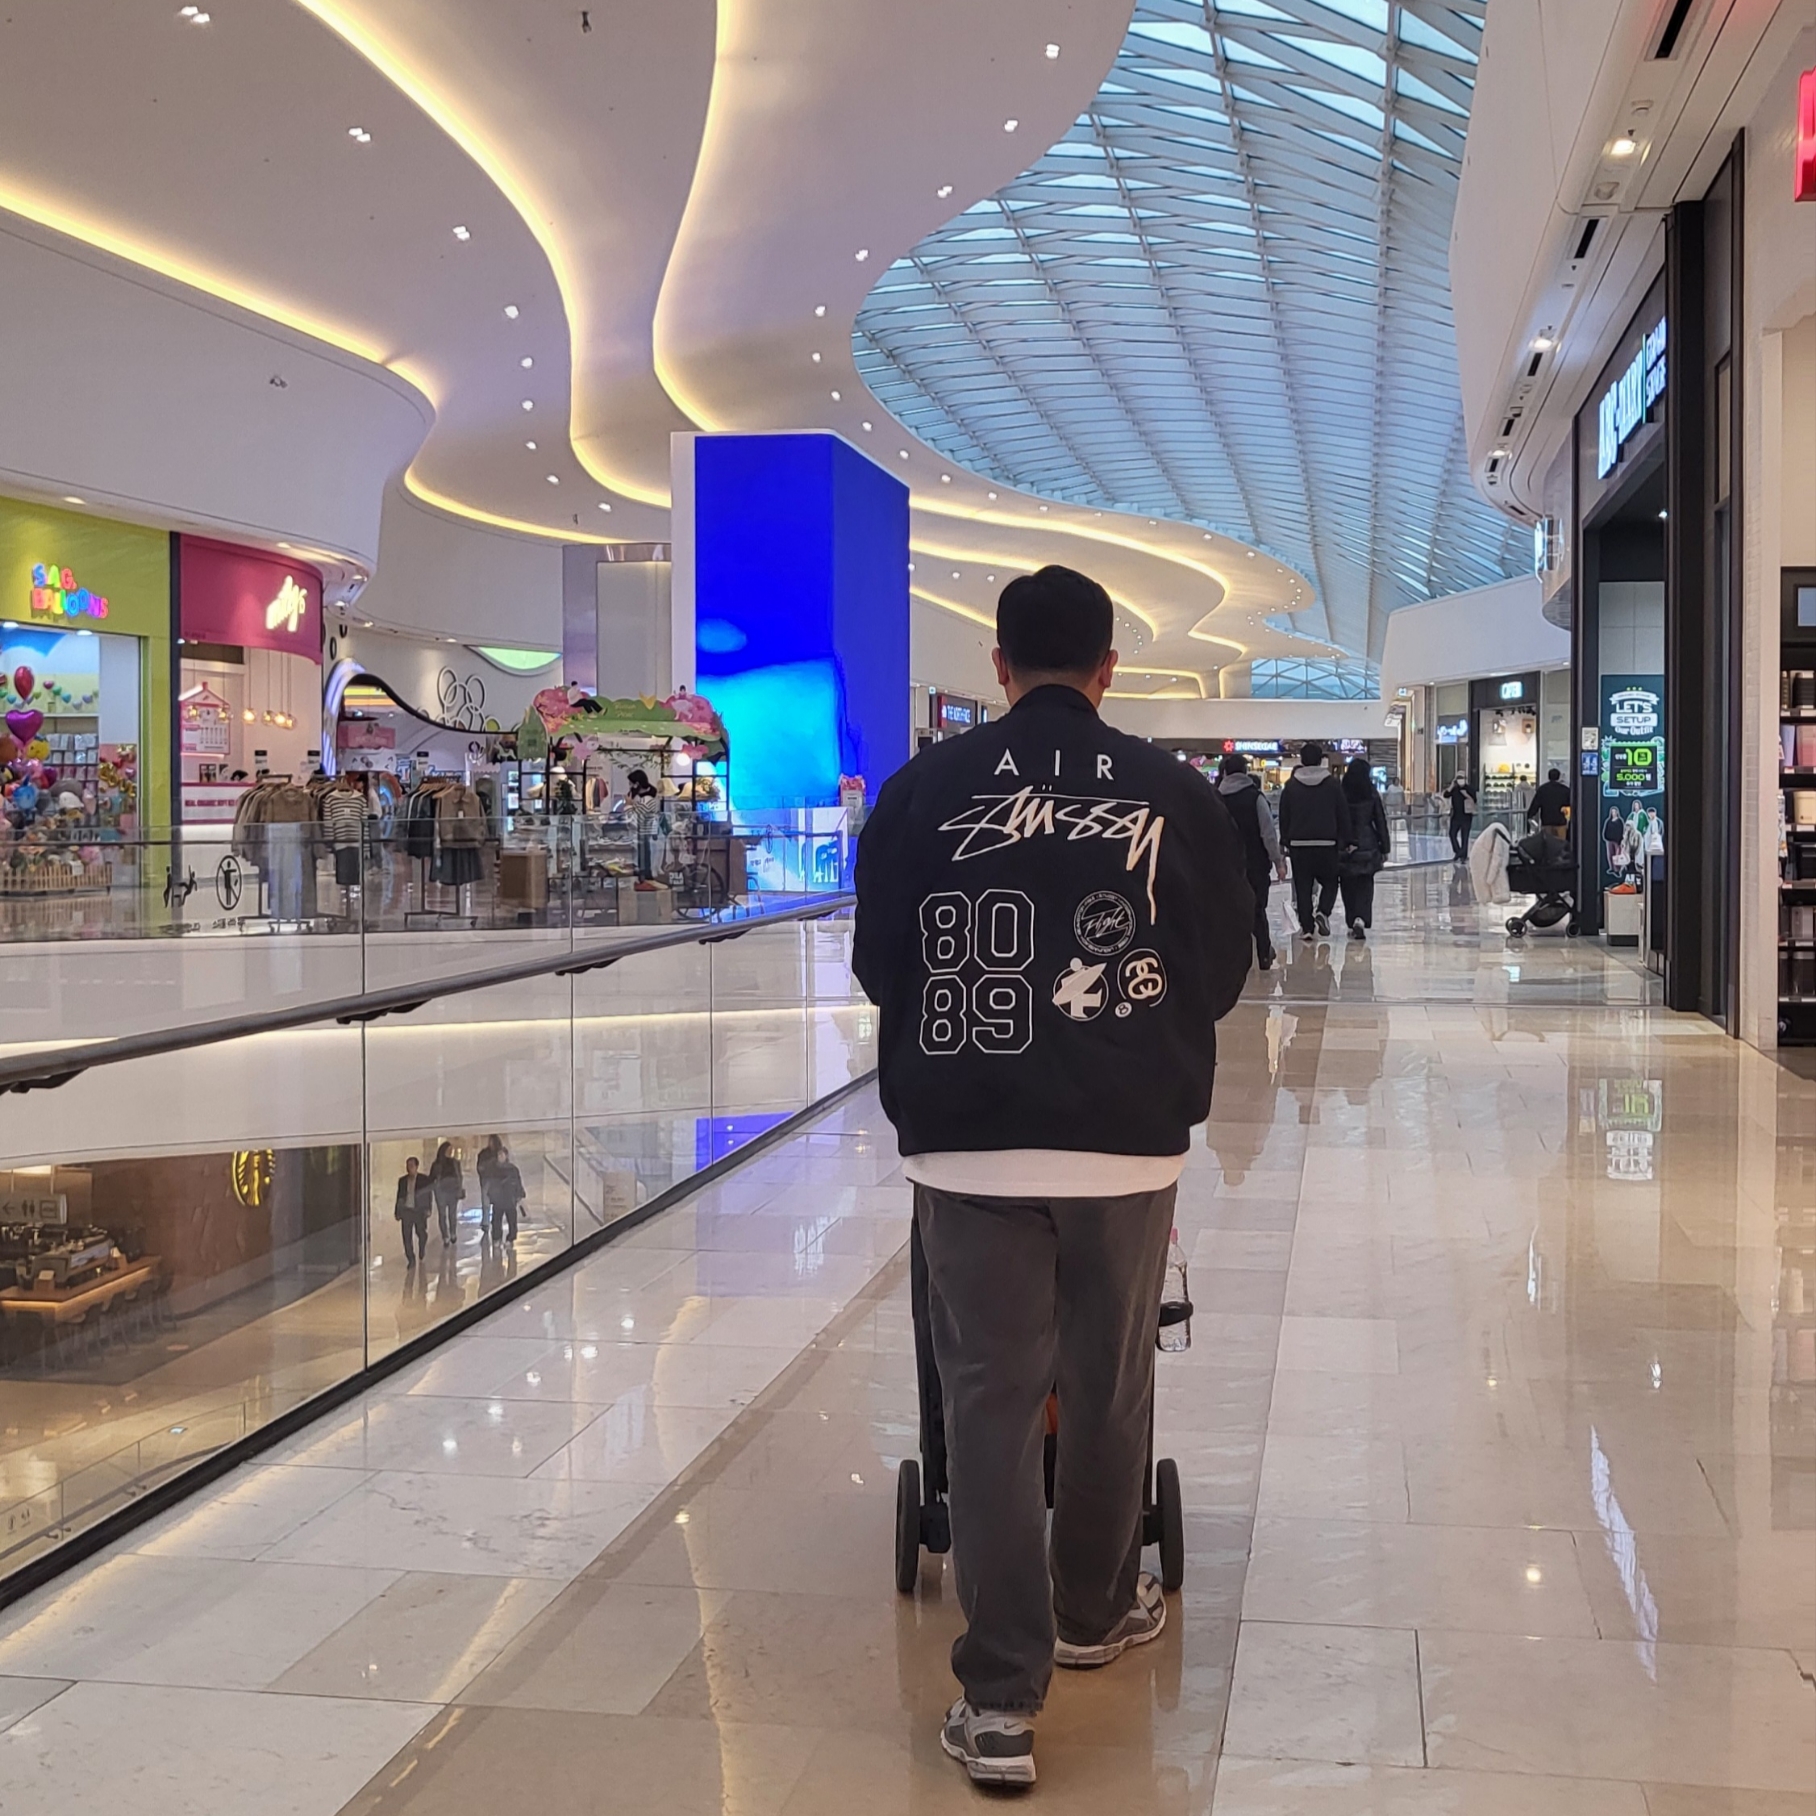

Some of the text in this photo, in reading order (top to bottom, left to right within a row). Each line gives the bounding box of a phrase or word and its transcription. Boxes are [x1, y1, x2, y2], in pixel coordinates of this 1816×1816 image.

[1616, 716, 1651, 724] SETUP
[994, 748, 1114, 780] AIR
[919, 889, 1034, 973] 80
[919, 974, 1033, 1055] 89
